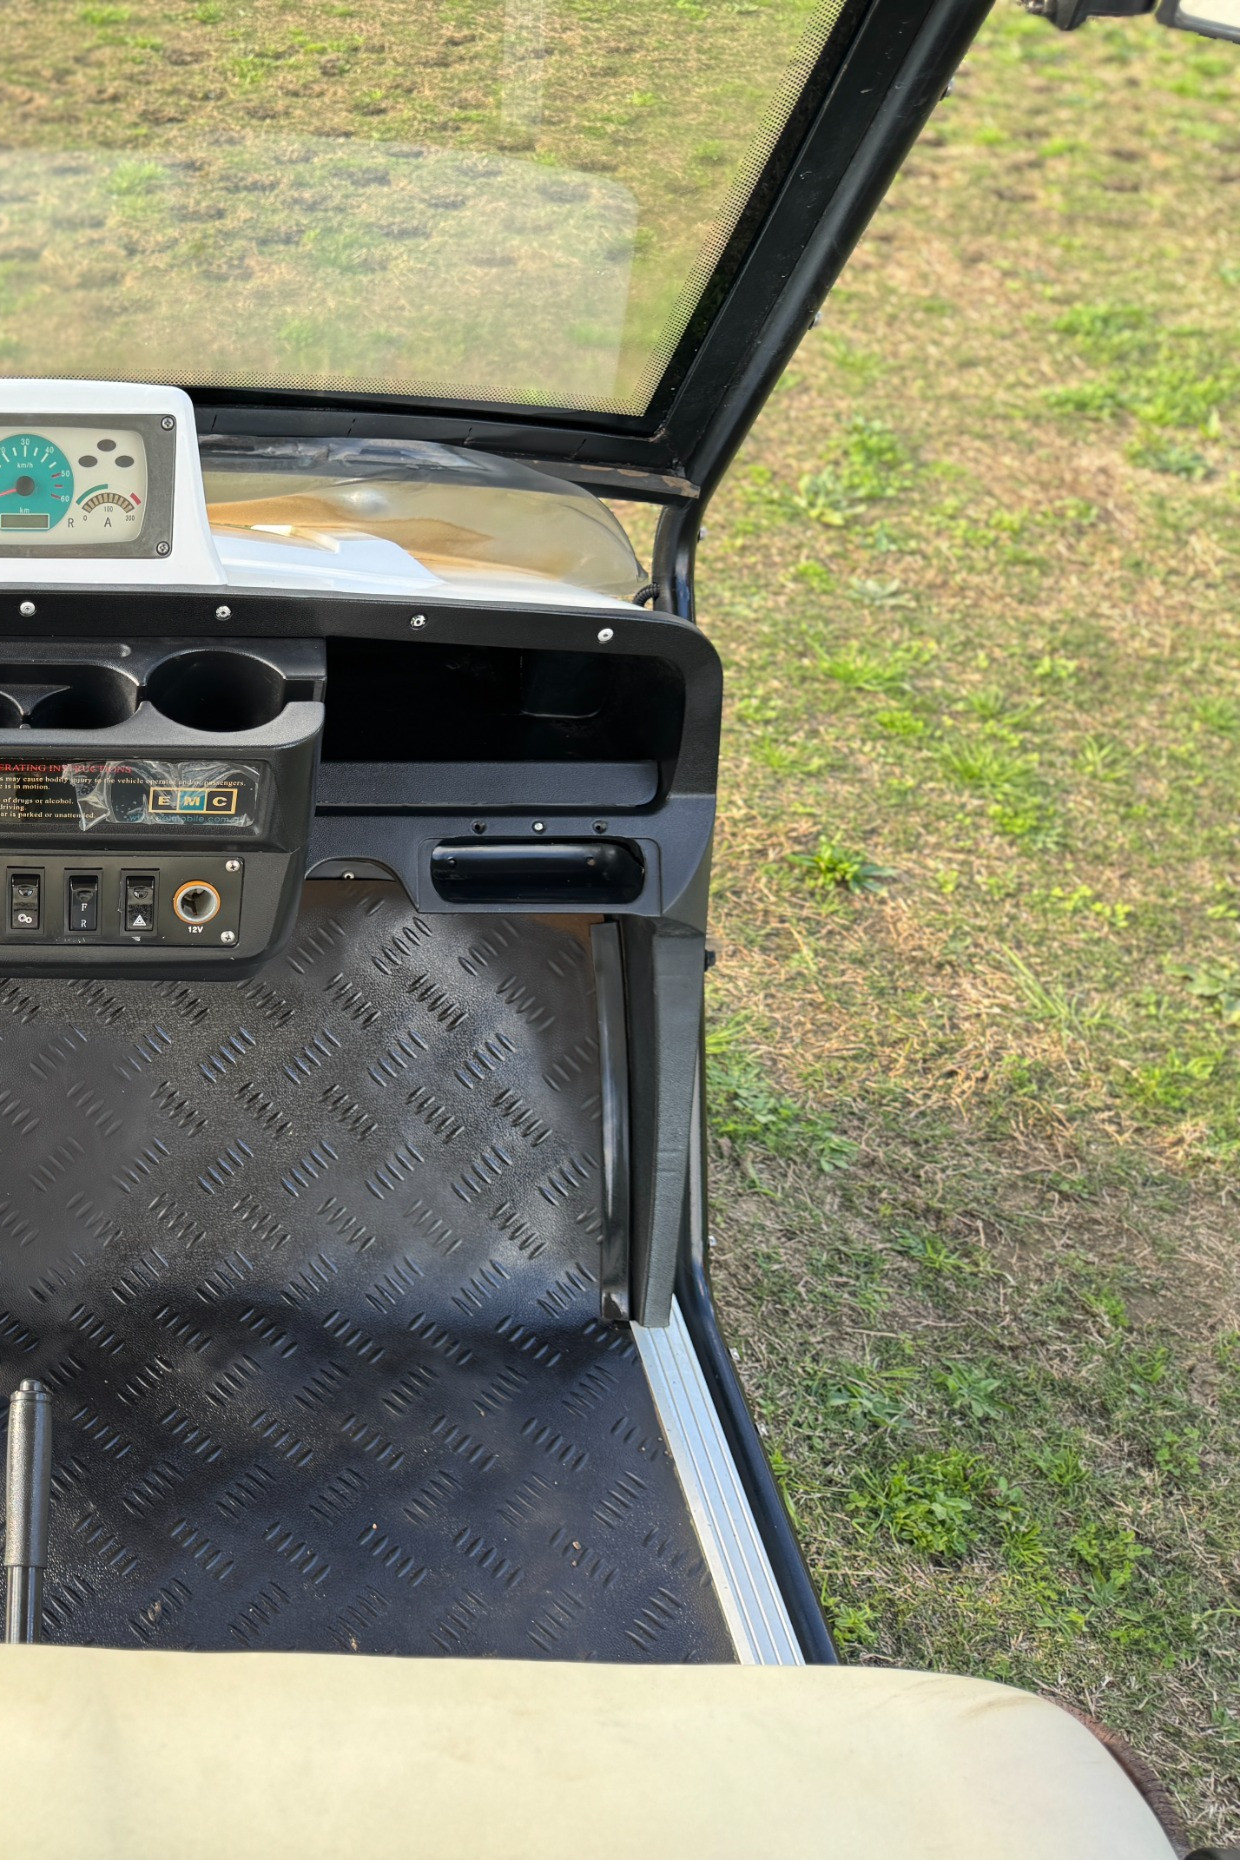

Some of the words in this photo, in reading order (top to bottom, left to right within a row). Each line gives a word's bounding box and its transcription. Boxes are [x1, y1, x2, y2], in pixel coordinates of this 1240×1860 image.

[20, 438, 30, 446] 30
[45, 446, 55, 454] 40
[61, 470, 70, 478] 50
[68, 517, 74, 528] R
[104, 517, 112, 528] A
[117, 777, 144, 785] vehicle
[13, 797, 33, 805] drugs
[81, 903, 88, 912] F
[80, 919, 87, 928] R
[187, 926, 204, 934] 12V
